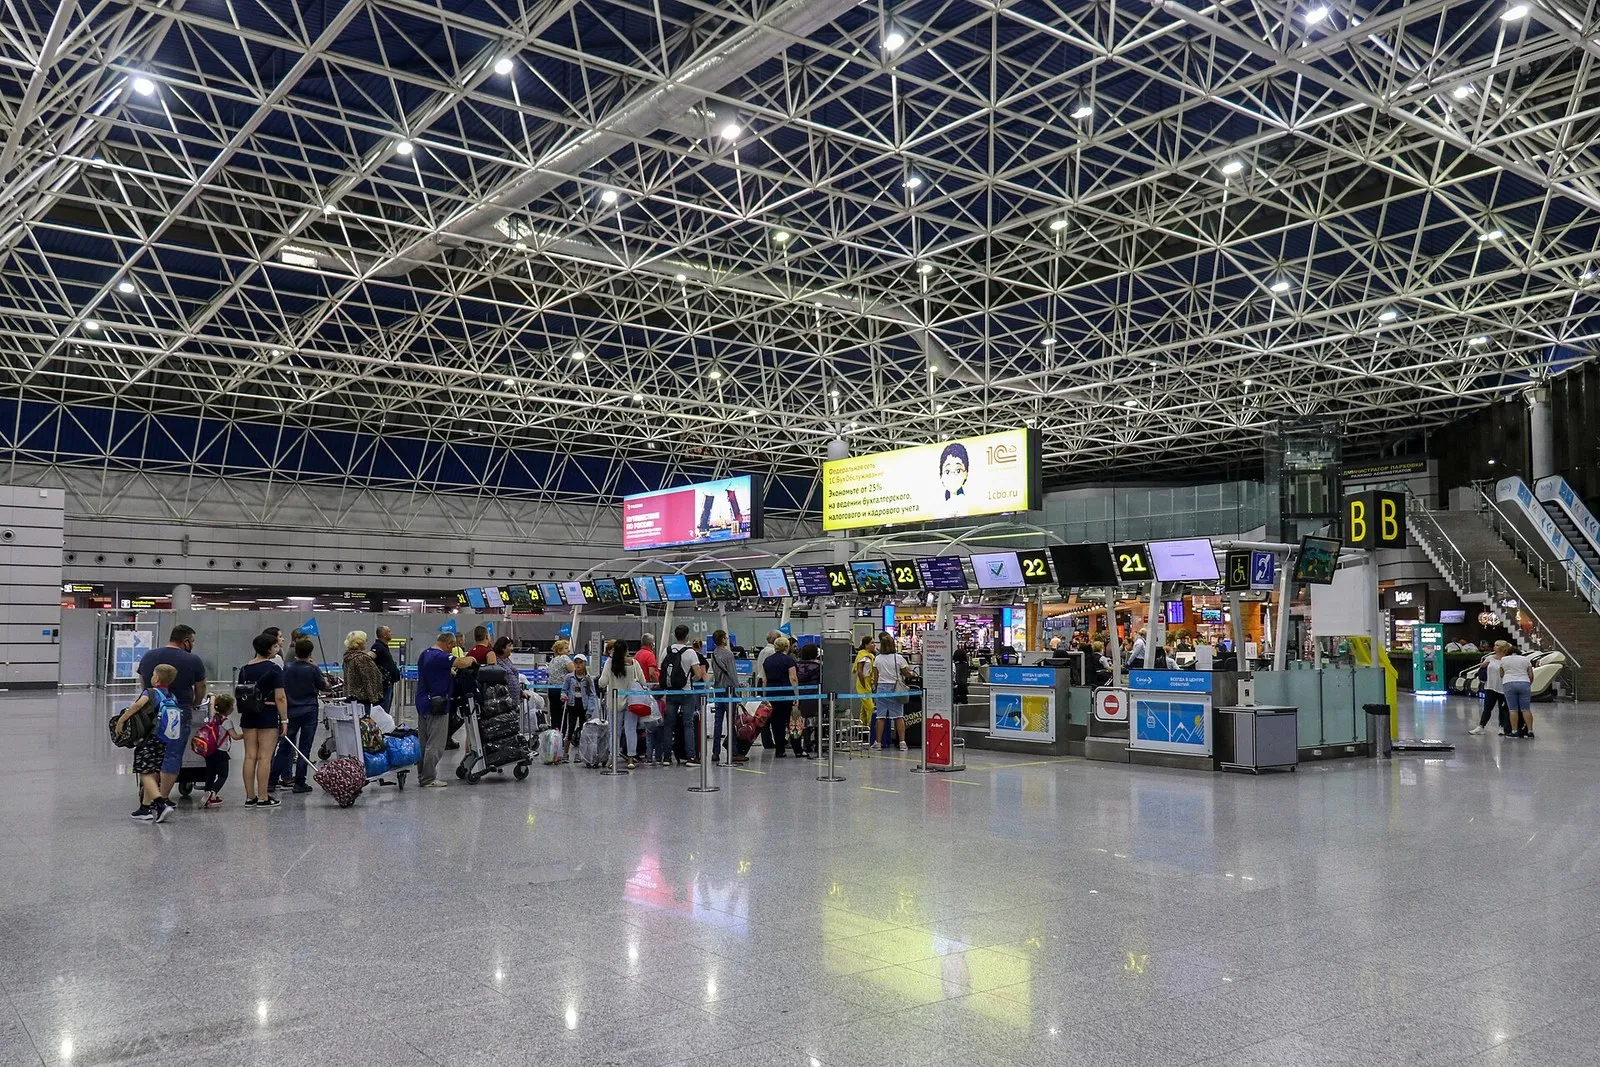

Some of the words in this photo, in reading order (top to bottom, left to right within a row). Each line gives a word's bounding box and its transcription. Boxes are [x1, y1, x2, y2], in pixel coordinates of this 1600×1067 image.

[828, 464, 864, 475] Федеральная
[1343, 466, 1388, 476] ДМИНИСТРАТОР
[828, 488, 860, 498] Экономьте
[868, 483, 882, 493] 25%
[988, 490, 1018, 500] 1cbo.ru
[836, 500, 862, 509] ведении
[828, 512, 861, 521] налогового
[868, 507, 900, 518] кадрового
[901, 504, 920, 514] учета
[1351, 501, 1366, 542] B
[1382, 499, 1398, 540] B
[1023, 558, 1047, 577] 22
[1119, 553, 1147, 572] 21
[830, 572, 846, 586] 24
[895, 567, 914, 582] 23
[620, 583, 631, 595] 27
[688, 580, 702, 592] 26
[738, 577, 753, 591] 25
[528, 589, 539, 600] 29
[582, 586, 594, 598] 28
[457, 594, 466, 604] 31
